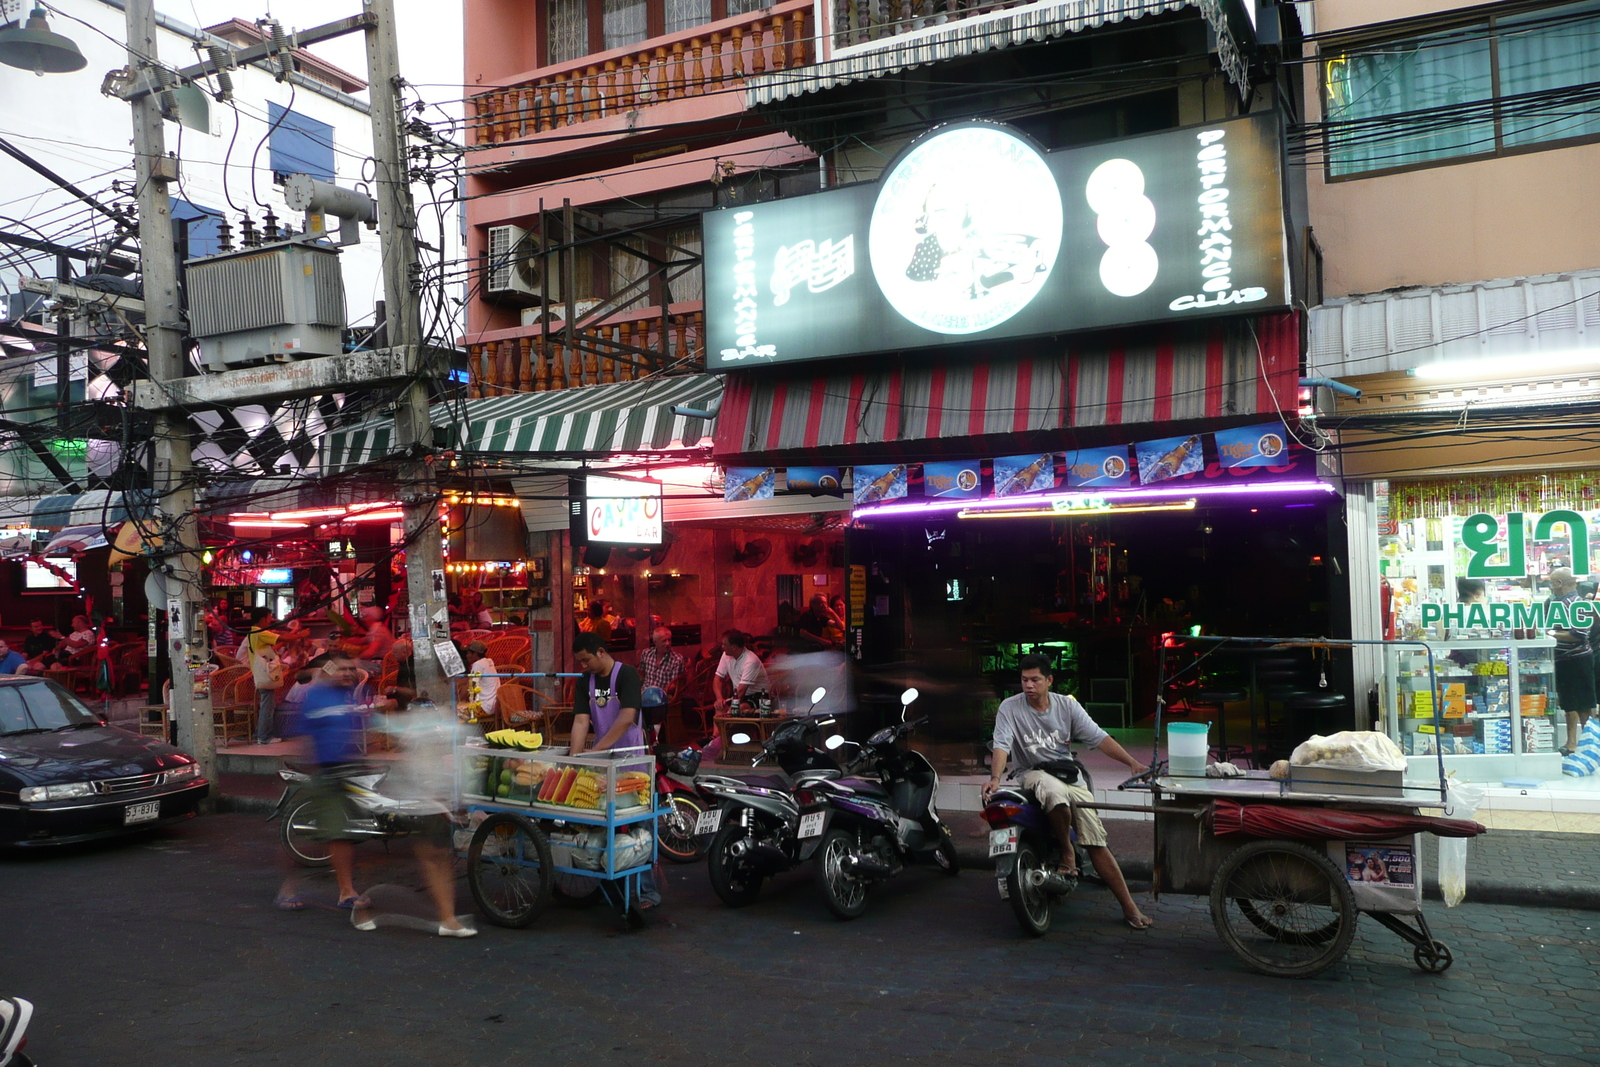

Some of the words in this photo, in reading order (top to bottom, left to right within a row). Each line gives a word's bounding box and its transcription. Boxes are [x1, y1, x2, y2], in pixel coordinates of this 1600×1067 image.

[1197, 130, 1232, 292] PERFORMANCE
[1169, 286, 1268, 311] CLUB
[1219, 442, 1254, 458] Tiger
[926, 475, 954, 489] Tiger
[1461, 510, 1590, 579] ยา
